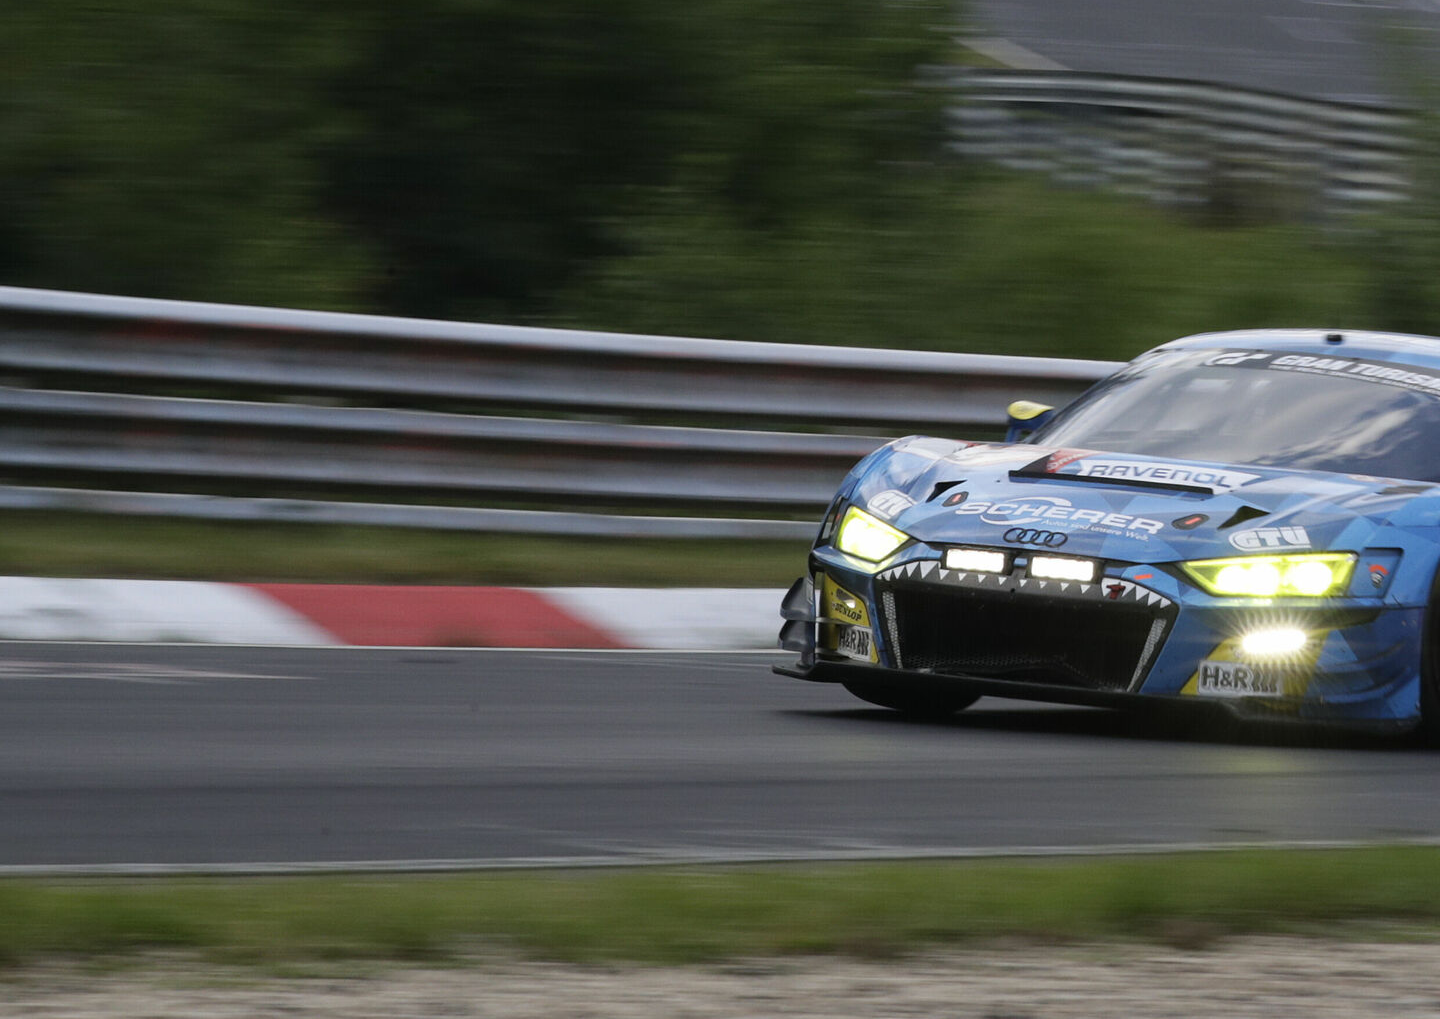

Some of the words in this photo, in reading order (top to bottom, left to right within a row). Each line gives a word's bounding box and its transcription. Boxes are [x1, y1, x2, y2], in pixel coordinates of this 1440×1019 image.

[1271, 355, 1352, 371] GRAN
[1087, 463, 1232, 489] RAVENOL
[955, 501, 1165, 536] SCHERER
[1232, 525, 1311, 548] GTU
[834, 602, 862, 621] DUNLOP
[1201, 664, 1249, 689] H&R
